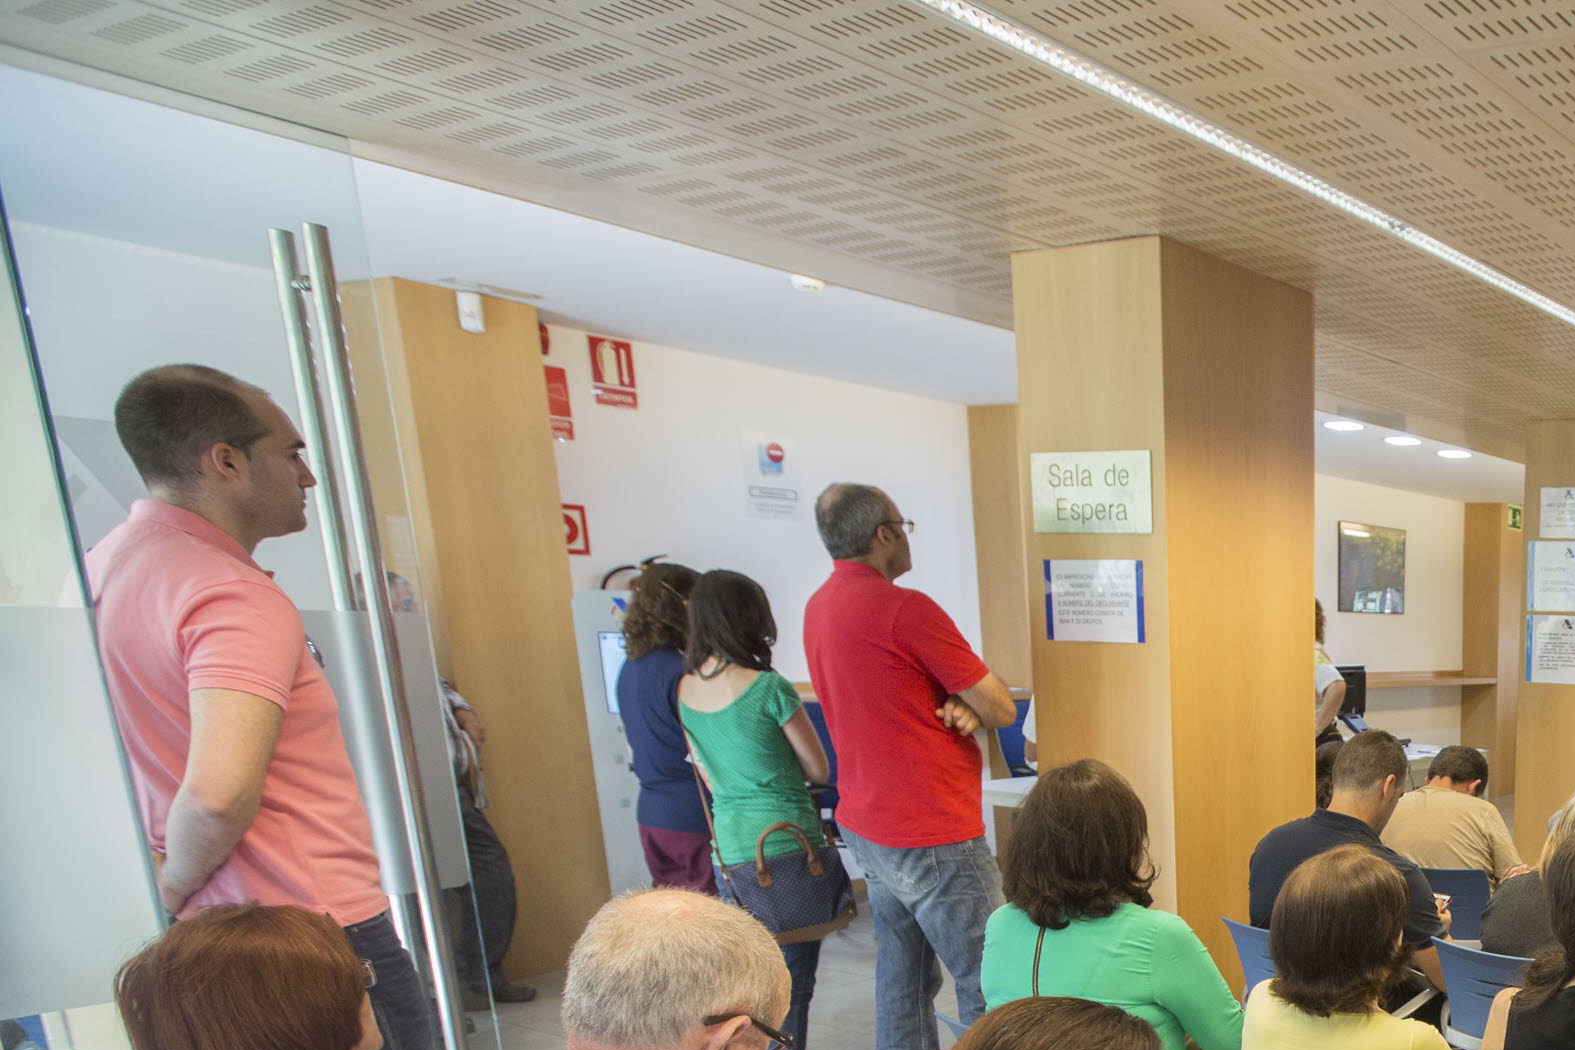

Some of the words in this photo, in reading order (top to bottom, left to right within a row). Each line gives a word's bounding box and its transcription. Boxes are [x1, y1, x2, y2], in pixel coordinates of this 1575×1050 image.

[1048, 463, 1093, 488] Sala
[1104, 463, 1129, 487] de
[1056, 497, 1128, 525] Espera
